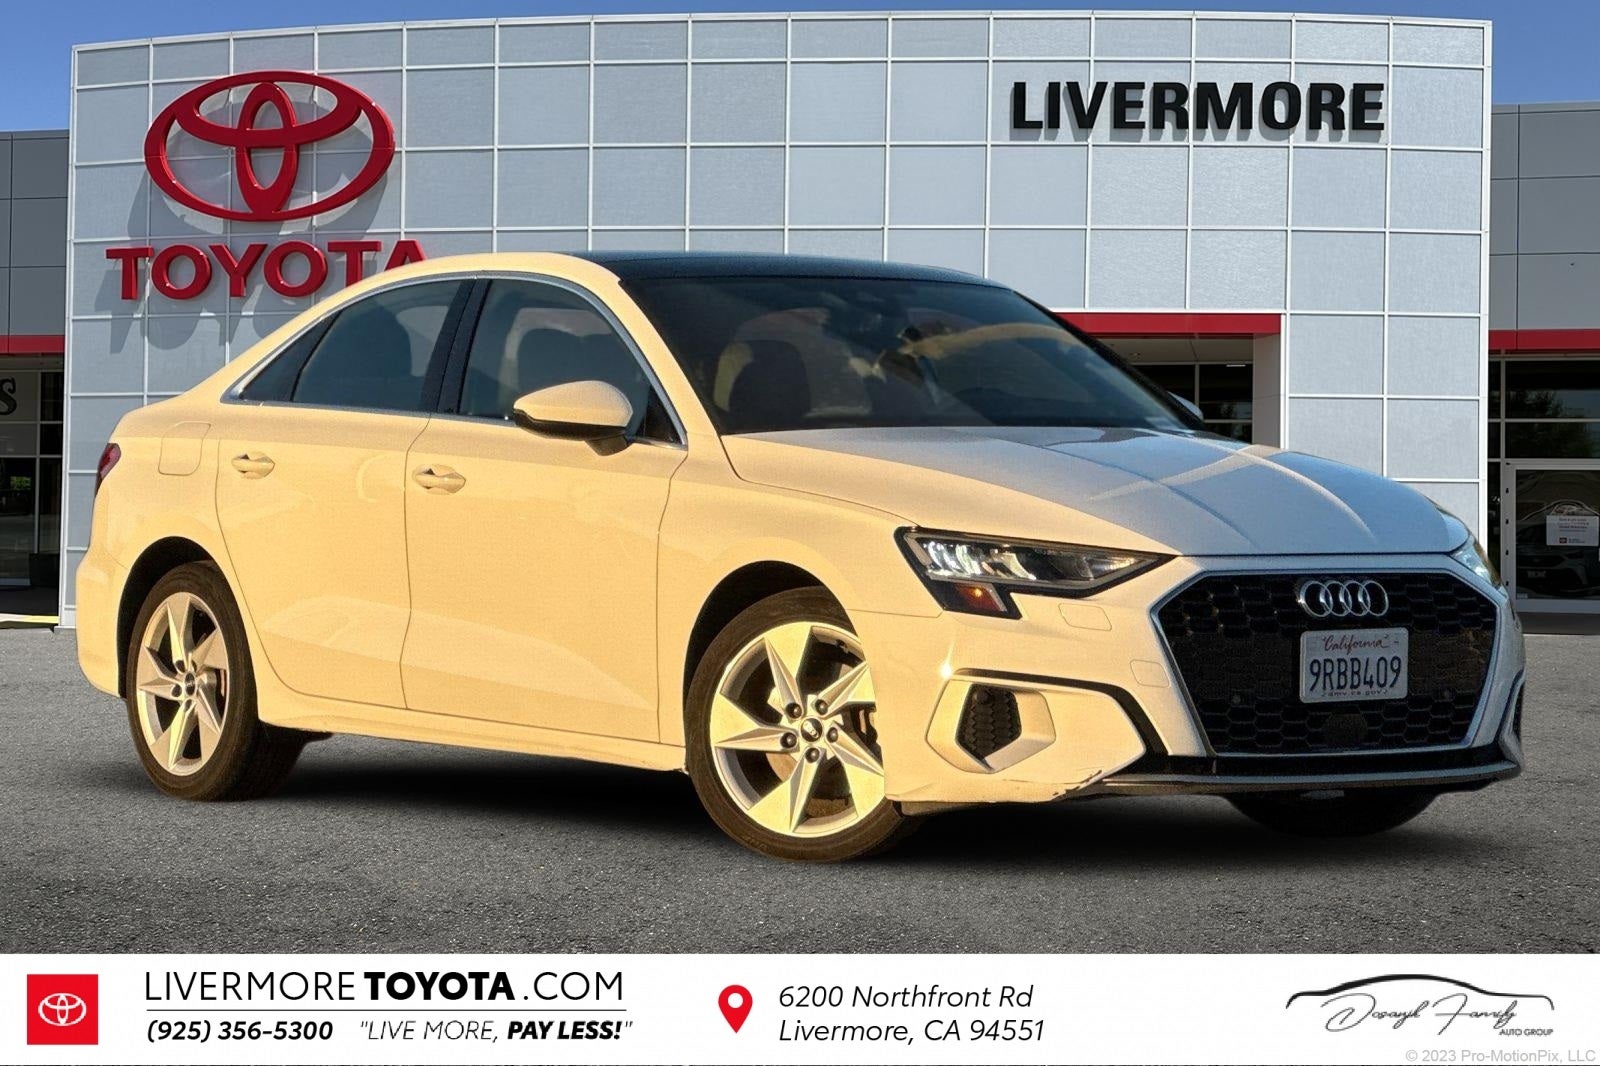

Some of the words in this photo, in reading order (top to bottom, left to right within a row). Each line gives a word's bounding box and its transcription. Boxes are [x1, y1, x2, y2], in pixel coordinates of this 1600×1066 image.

[1011, 81, 1385, 132] LIVERMORE
[1322, 634, 1390, 656] California
[1309, 655, 1402, 692] 9RBB409
